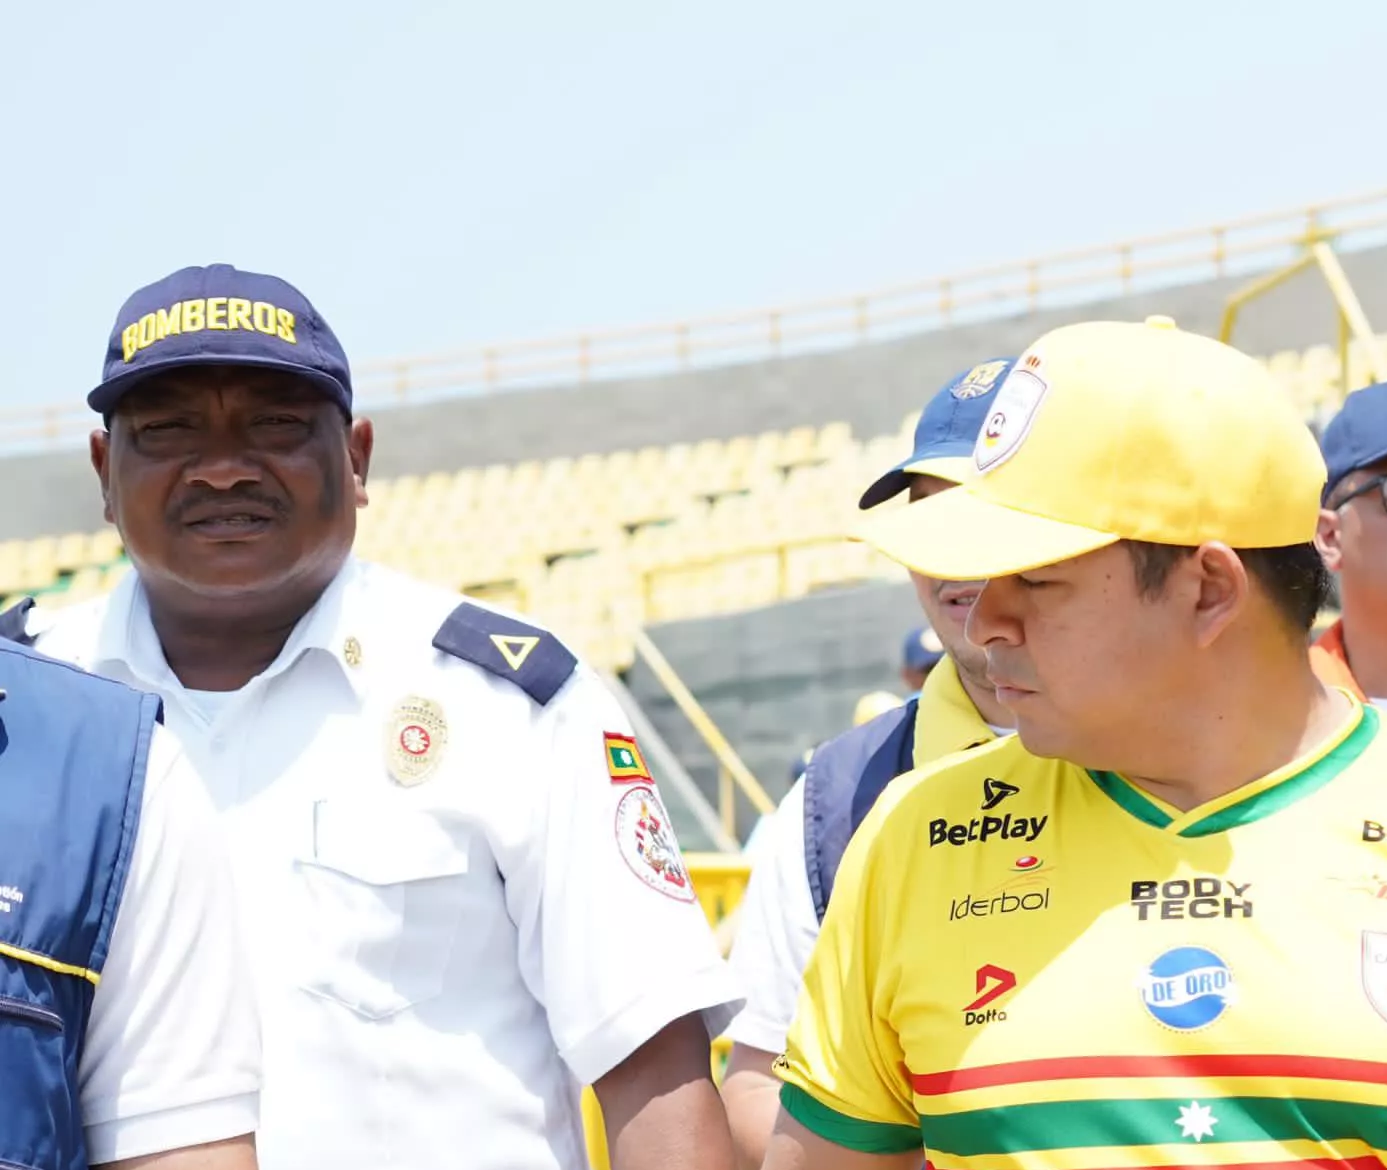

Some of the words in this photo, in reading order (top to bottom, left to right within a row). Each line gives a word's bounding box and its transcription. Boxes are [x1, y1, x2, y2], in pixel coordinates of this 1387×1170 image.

[122, 297, 297, 363] BOMBEROS
[929, 813, 1048, 848] BetPlay
[950, 888, 1049, 921] Iderbol
[1131, 878, 1251, 900] BODY
[1131, 898, 1253, 921] TECH
[1152, 980, 1176, 1002] DE
[1186, 970, 1226, 996] ORO
[965, 1009, 1007, 1026] Dotta
